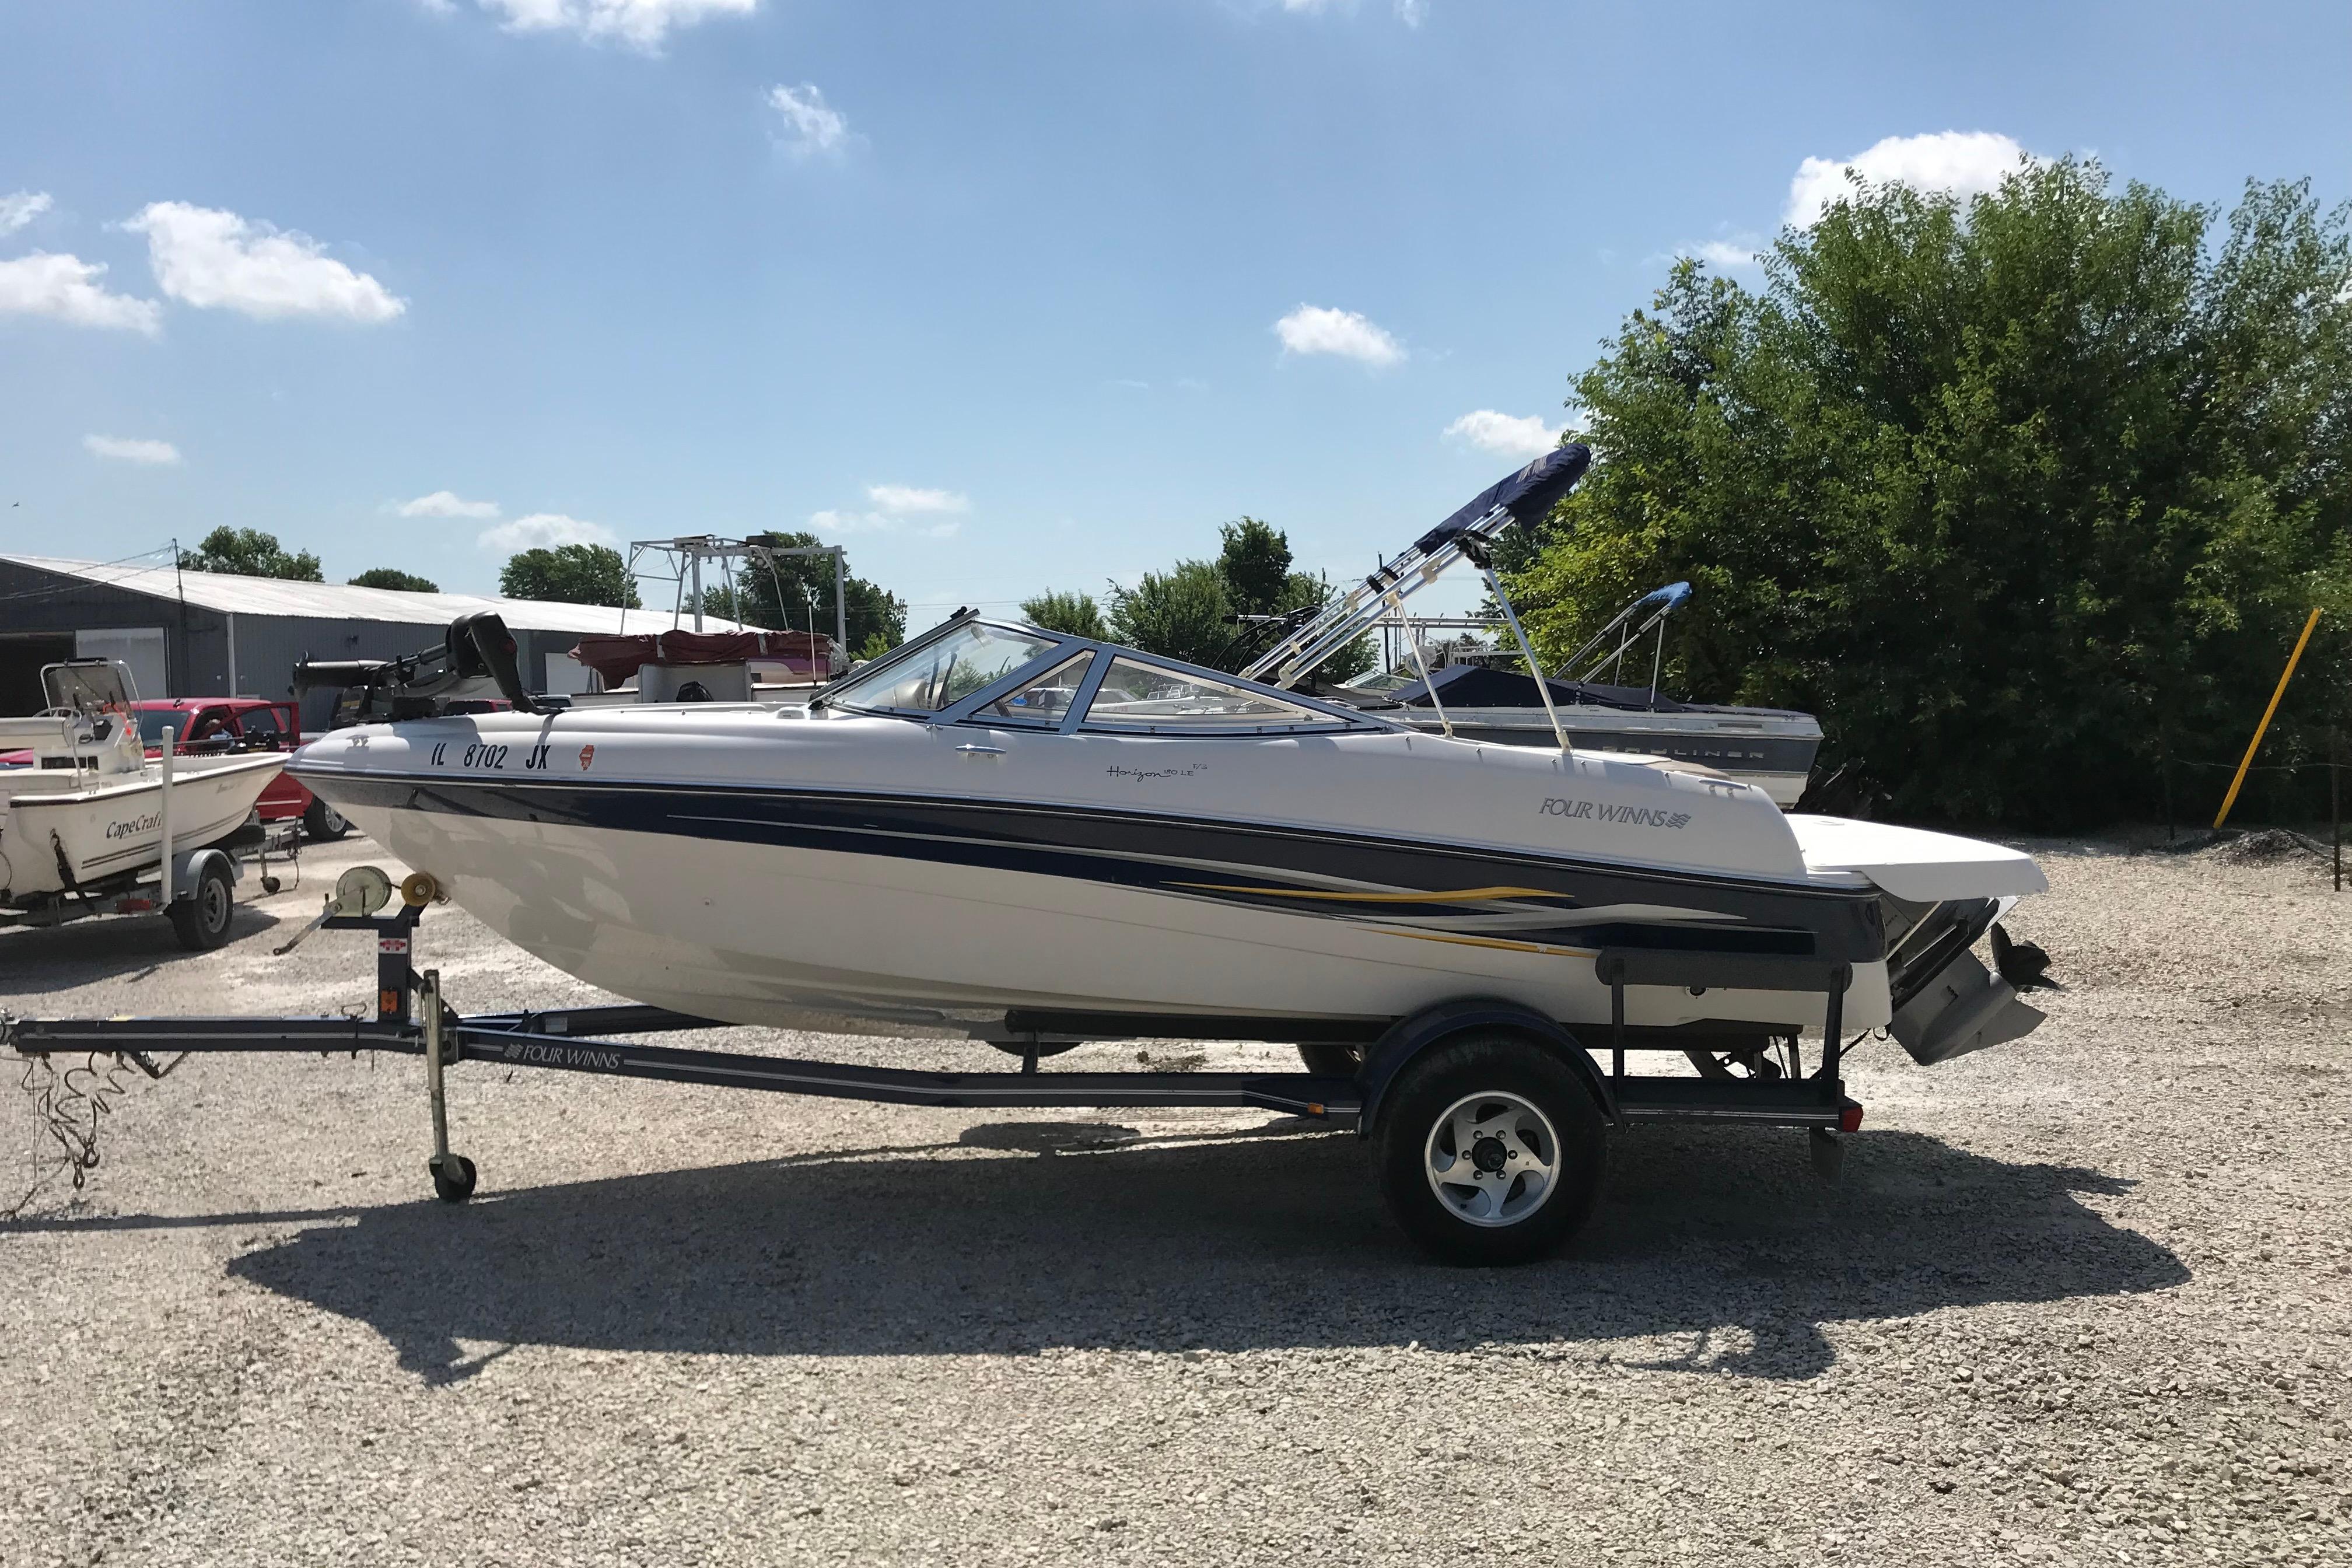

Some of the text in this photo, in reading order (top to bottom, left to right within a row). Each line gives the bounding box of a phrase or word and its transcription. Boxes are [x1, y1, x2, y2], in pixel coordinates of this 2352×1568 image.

[431, 743, 551, 769] IL 8702 JX
[1107, 766, 1171, 782] Horizon
[1538, 797, 1668, 827] FOUR WINNS
[523, 1045, 621, 1069] FOUR WINNS
